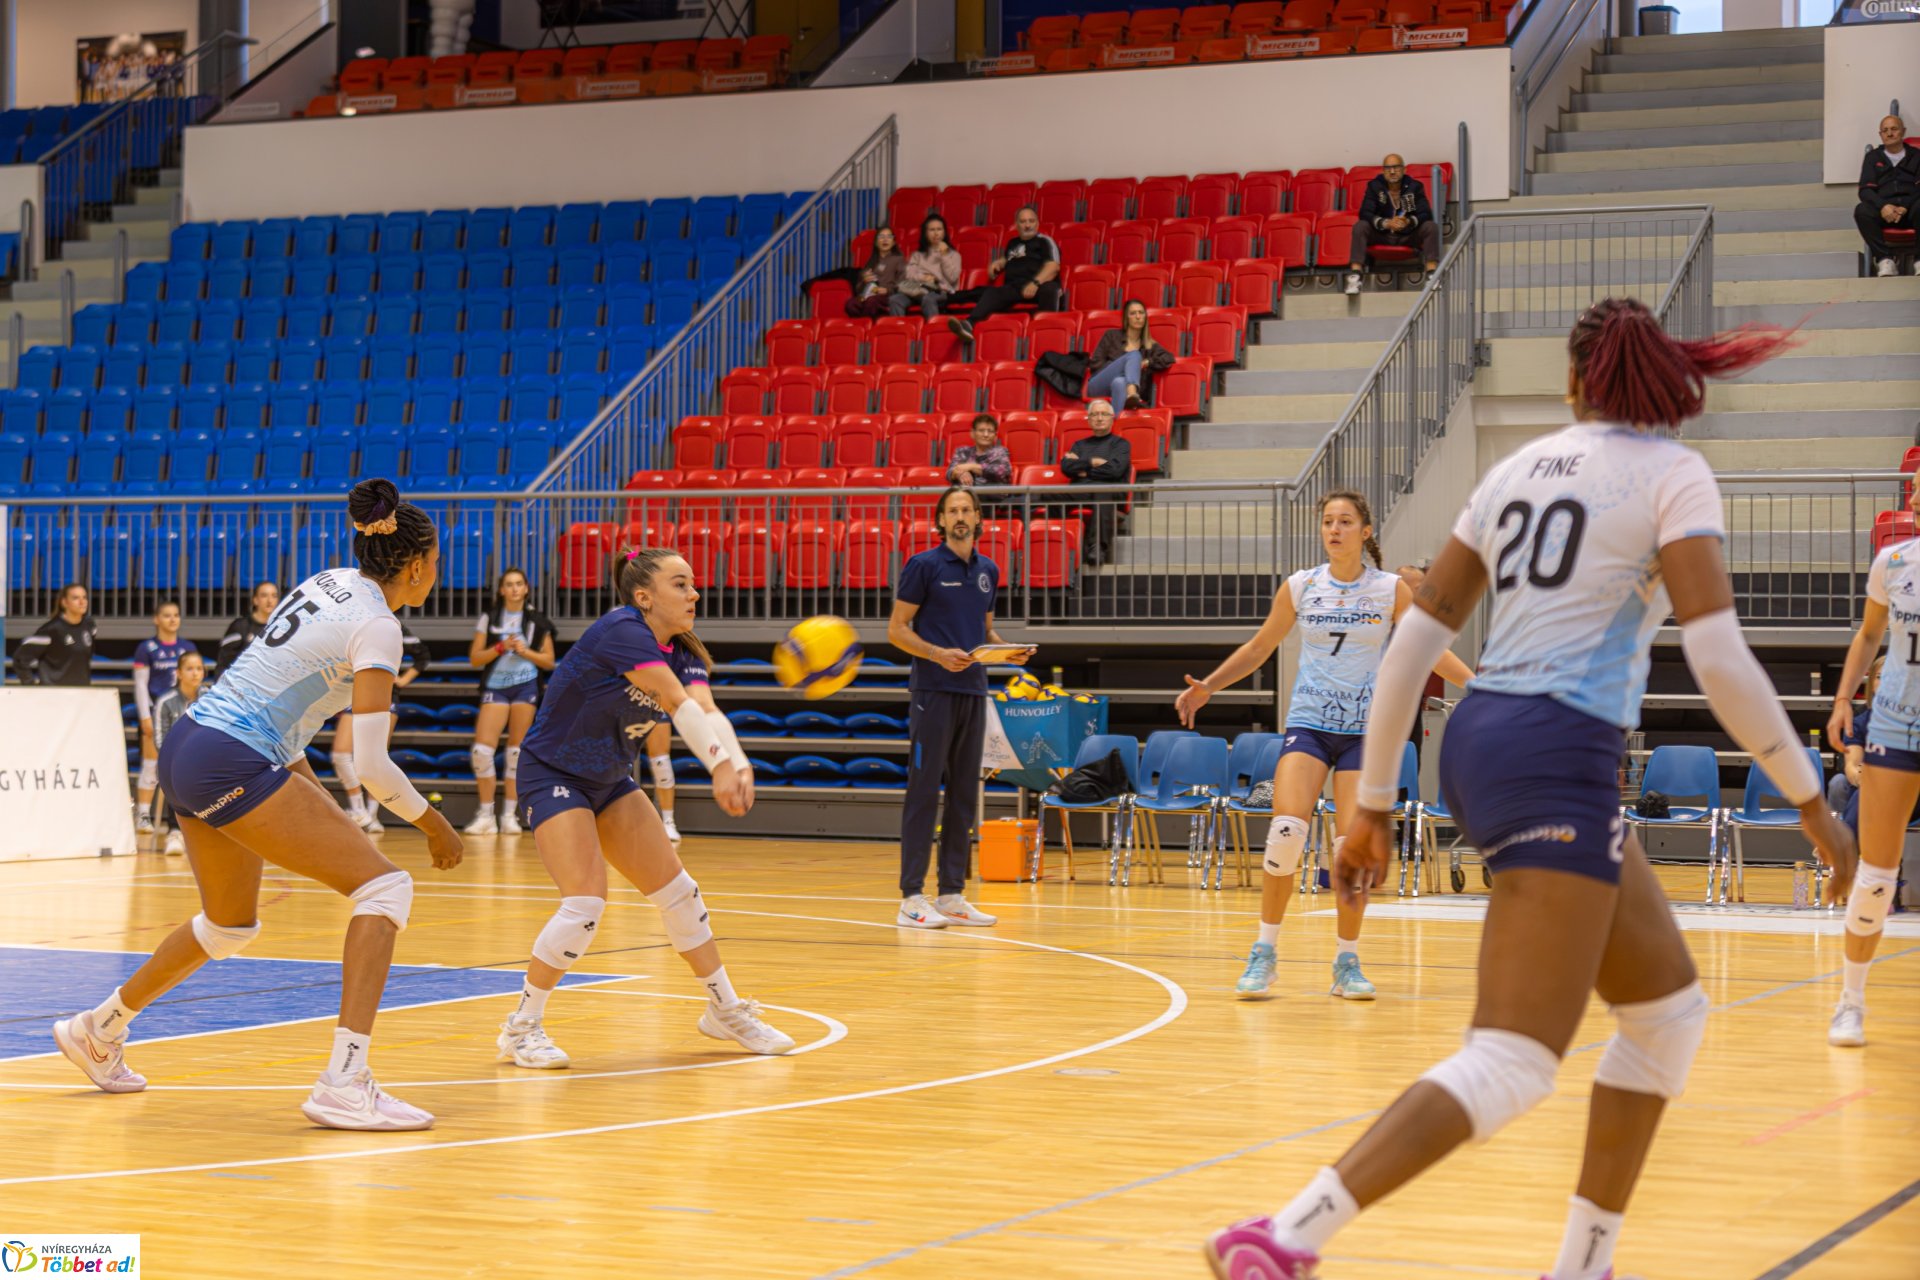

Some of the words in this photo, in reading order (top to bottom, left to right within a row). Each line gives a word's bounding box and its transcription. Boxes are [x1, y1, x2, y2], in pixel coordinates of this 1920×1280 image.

[1407, 30, 1466, 42] MICHELIN
[1261, 40, 1317, 50] MICHELIN
[1117, 49, 1171, 60] MICHELIN
[1528, 453, 1586, 480] FINE
[1496, 499, 1588, 594] 20
[257, 588, 321, 648] 15
[1302, 611, 1383, 625] ippmixPRO
[1328, 631, 1348, 657] 7
[1004, 704, 1062, 717] HUNVOLLEY
[625, 719, 657, 740] 4
[0, 763, 100, 791] GYHÁZA
[552, 785, 571, 799] 4
